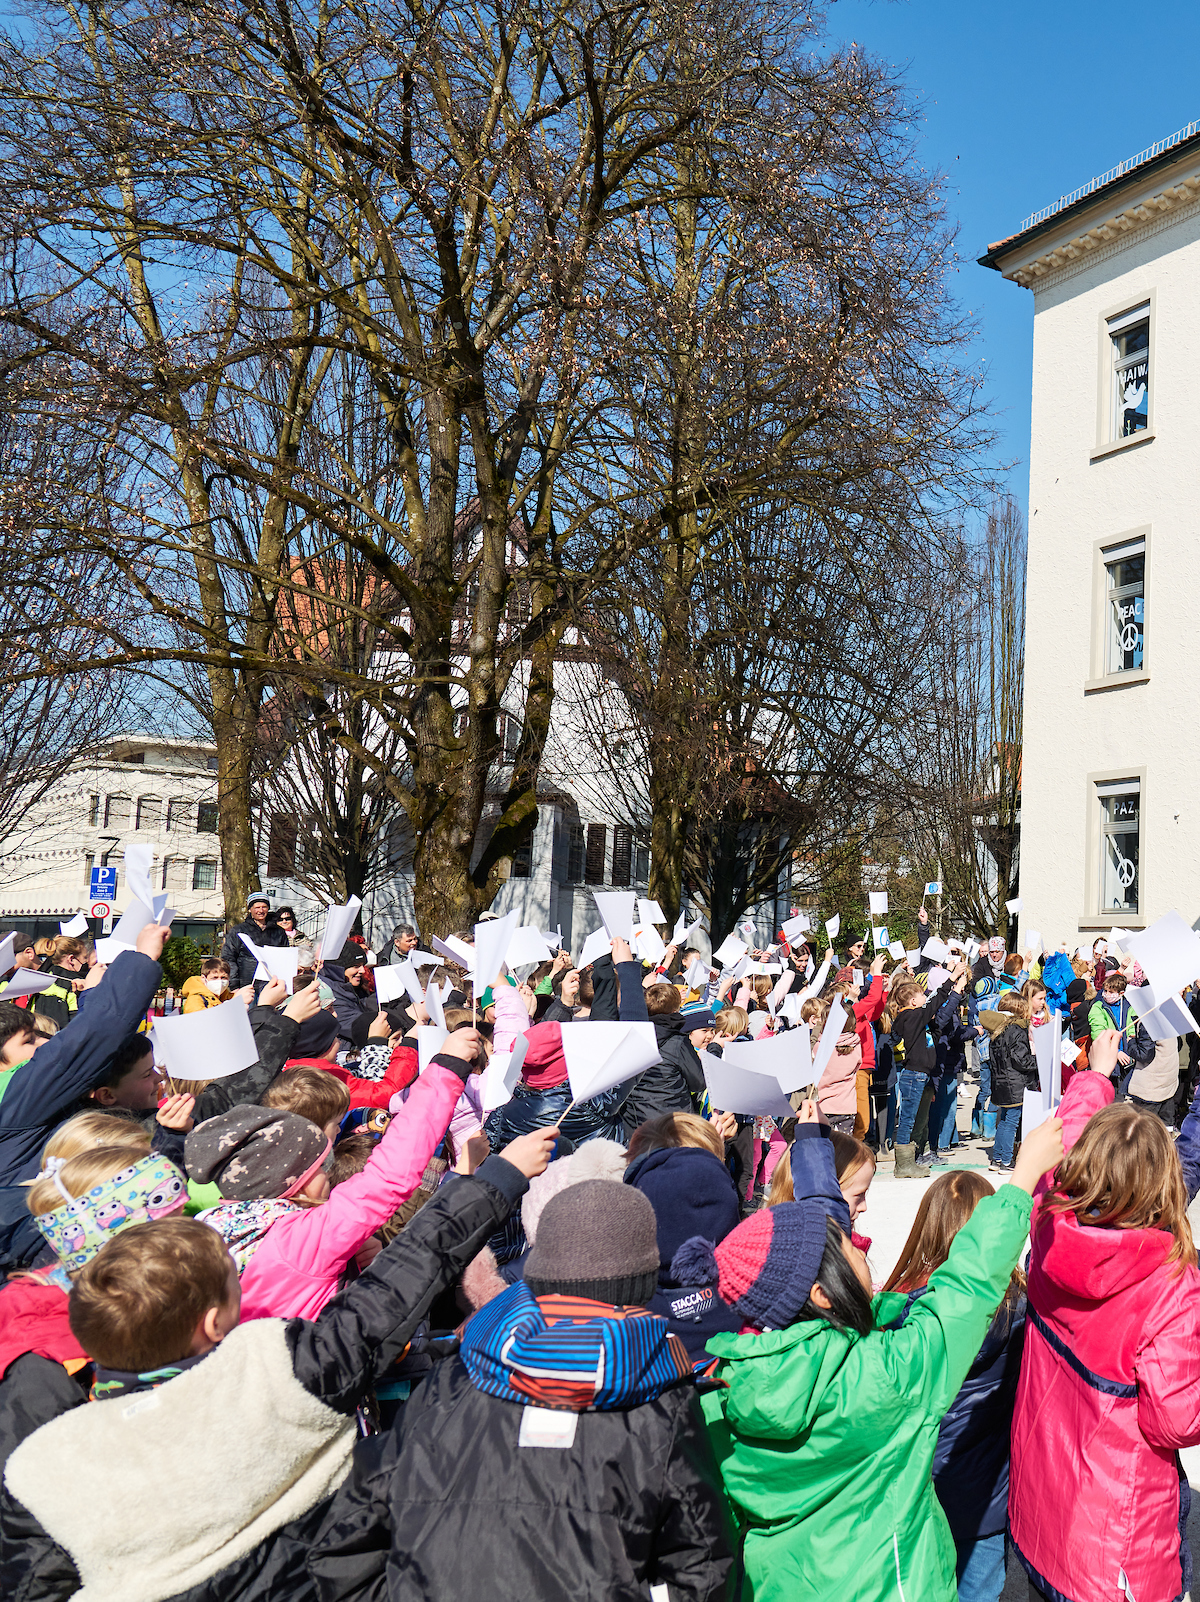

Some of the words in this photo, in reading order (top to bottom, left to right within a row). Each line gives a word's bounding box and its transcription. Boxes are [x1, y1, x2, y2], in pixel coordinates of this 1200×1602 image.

[1113, 801, 1135, 815] PAZ
[98, 868, 110, 883] P
[96, 906, 106, 915] 30
[671, 1288, 713, 1312] STACCATO
